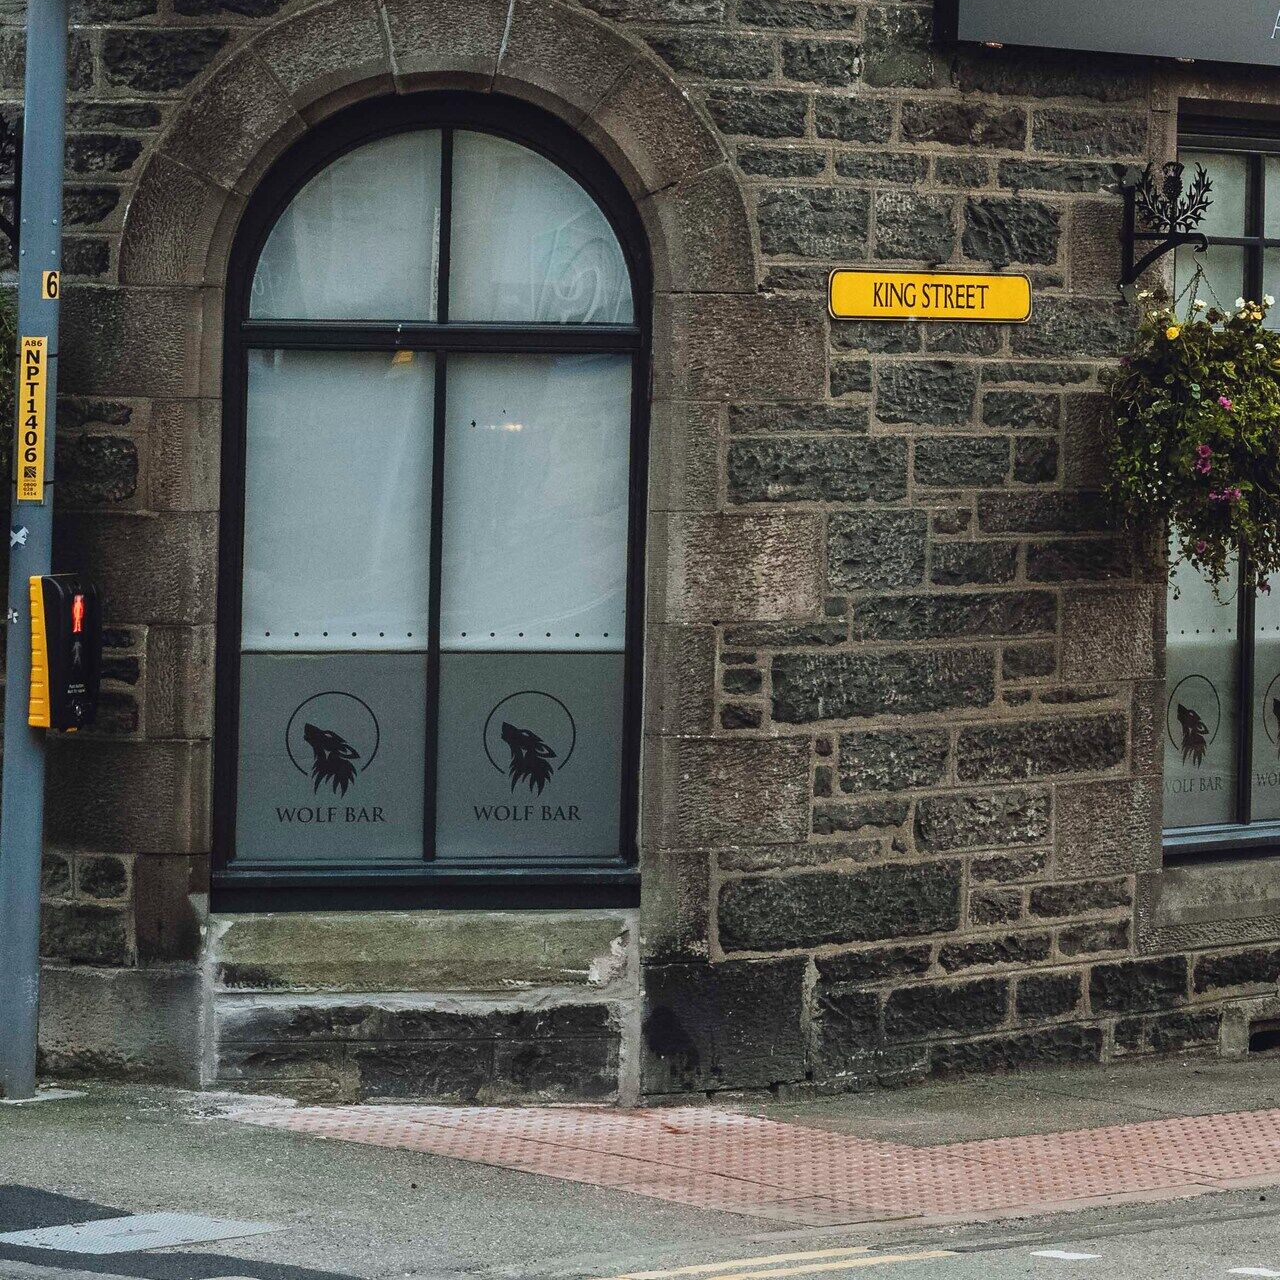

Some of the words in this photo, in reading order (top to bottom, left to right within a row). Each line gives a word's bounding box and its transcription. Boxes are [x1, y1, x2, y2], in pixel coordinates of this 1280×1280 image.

[46, 271, 58, 299] 6
[873, 282, 917, 308] KING
[921, 283, 990, 310] STREET
[24, 339, 43, 347] A86
[1199, 776, 1224, 792] BAR
[275, 806, 337, 823] WOLF
[344, 806, 386, 823] BAR
[473, 804, 534, 821] WOLF
[541, 804, 582, 821] BAR
